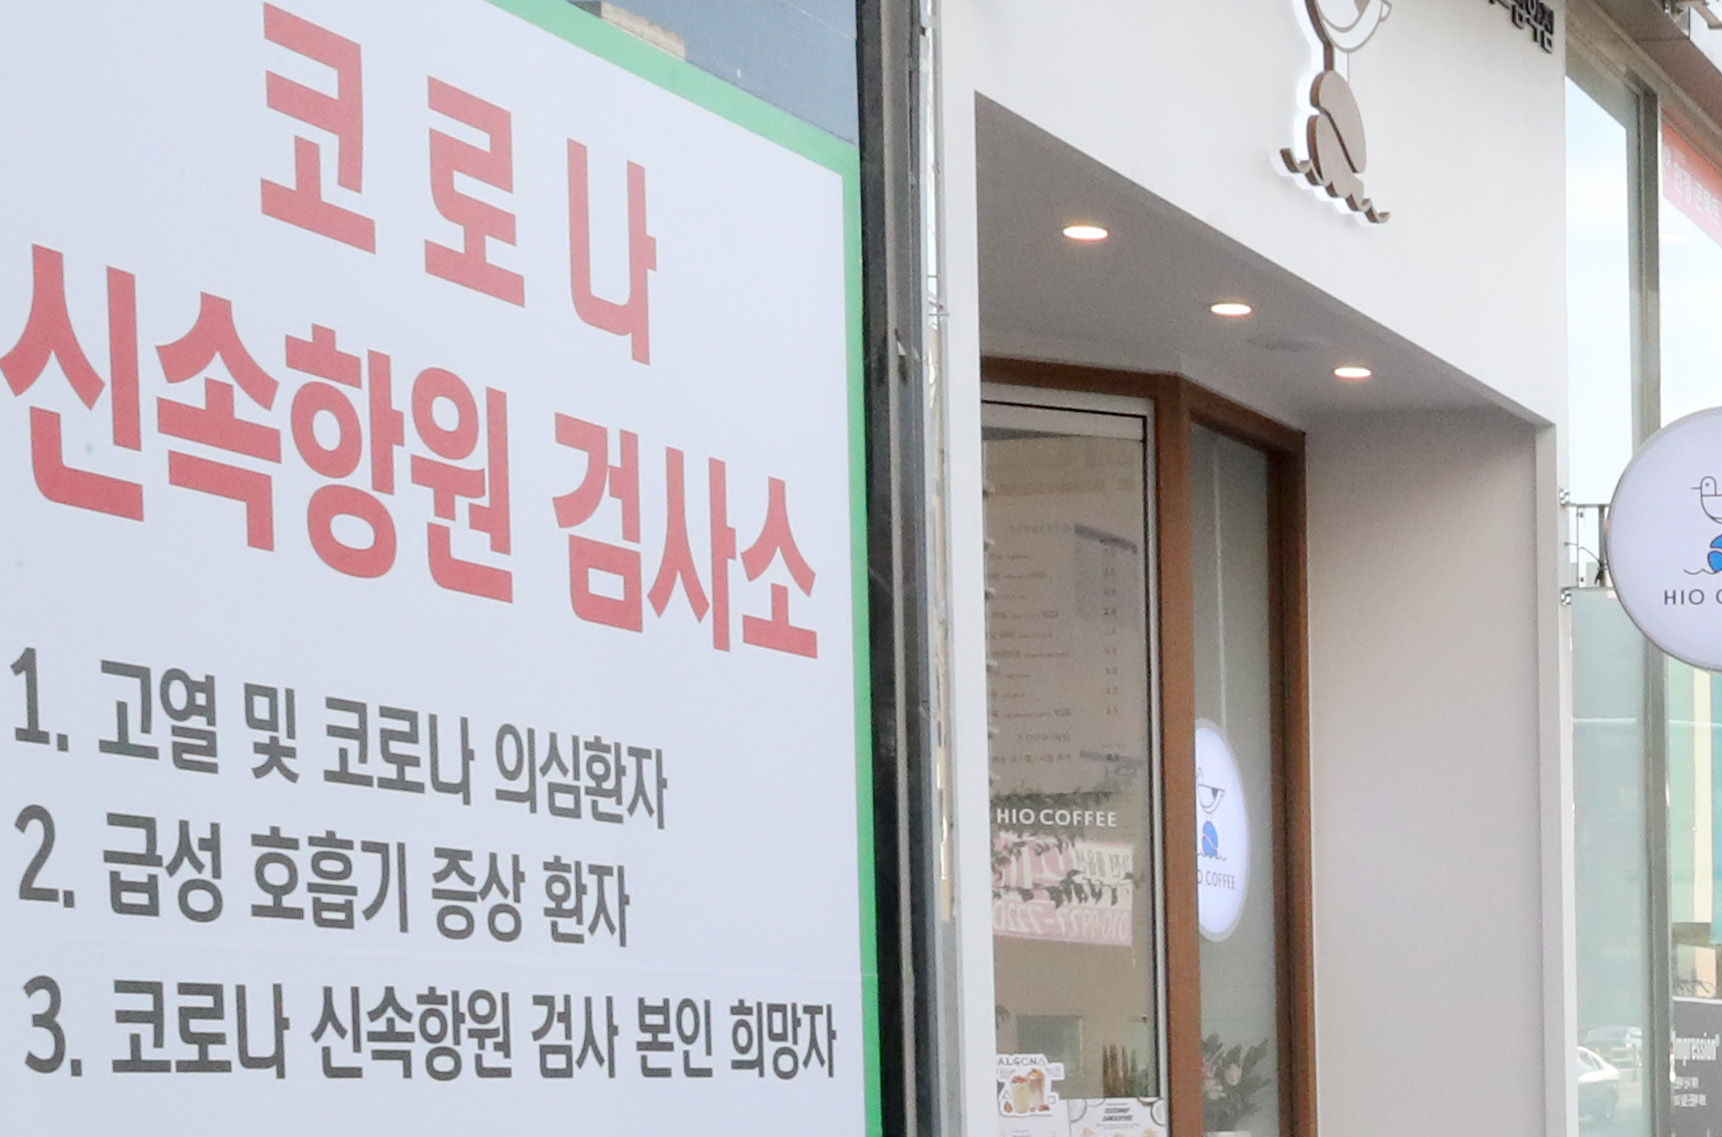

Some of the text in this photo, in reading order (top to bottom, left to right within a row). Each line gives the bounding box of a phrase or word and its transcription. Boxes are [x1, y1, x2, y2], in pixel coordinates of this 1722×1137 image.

[258, 0, 661, 370] 코로나
[0, 240, 517, 603] 신속항원
[552, 412, 818, 659] 검사소
[1664, 589, 1705, 605] HIO
[10, 647, 668, 830] 1. 고열 및 코로나 의심환자
[14, 804, 630, 948] 2. 급성 호흡기 증상 환자
[997, 808, 1117, 827] HIO COFFEE
[1205, 870, 1236, 891] COFFEE
[22, 975, 837, 1082] 3. 코로나 신속항원 검사 본인 희망자
